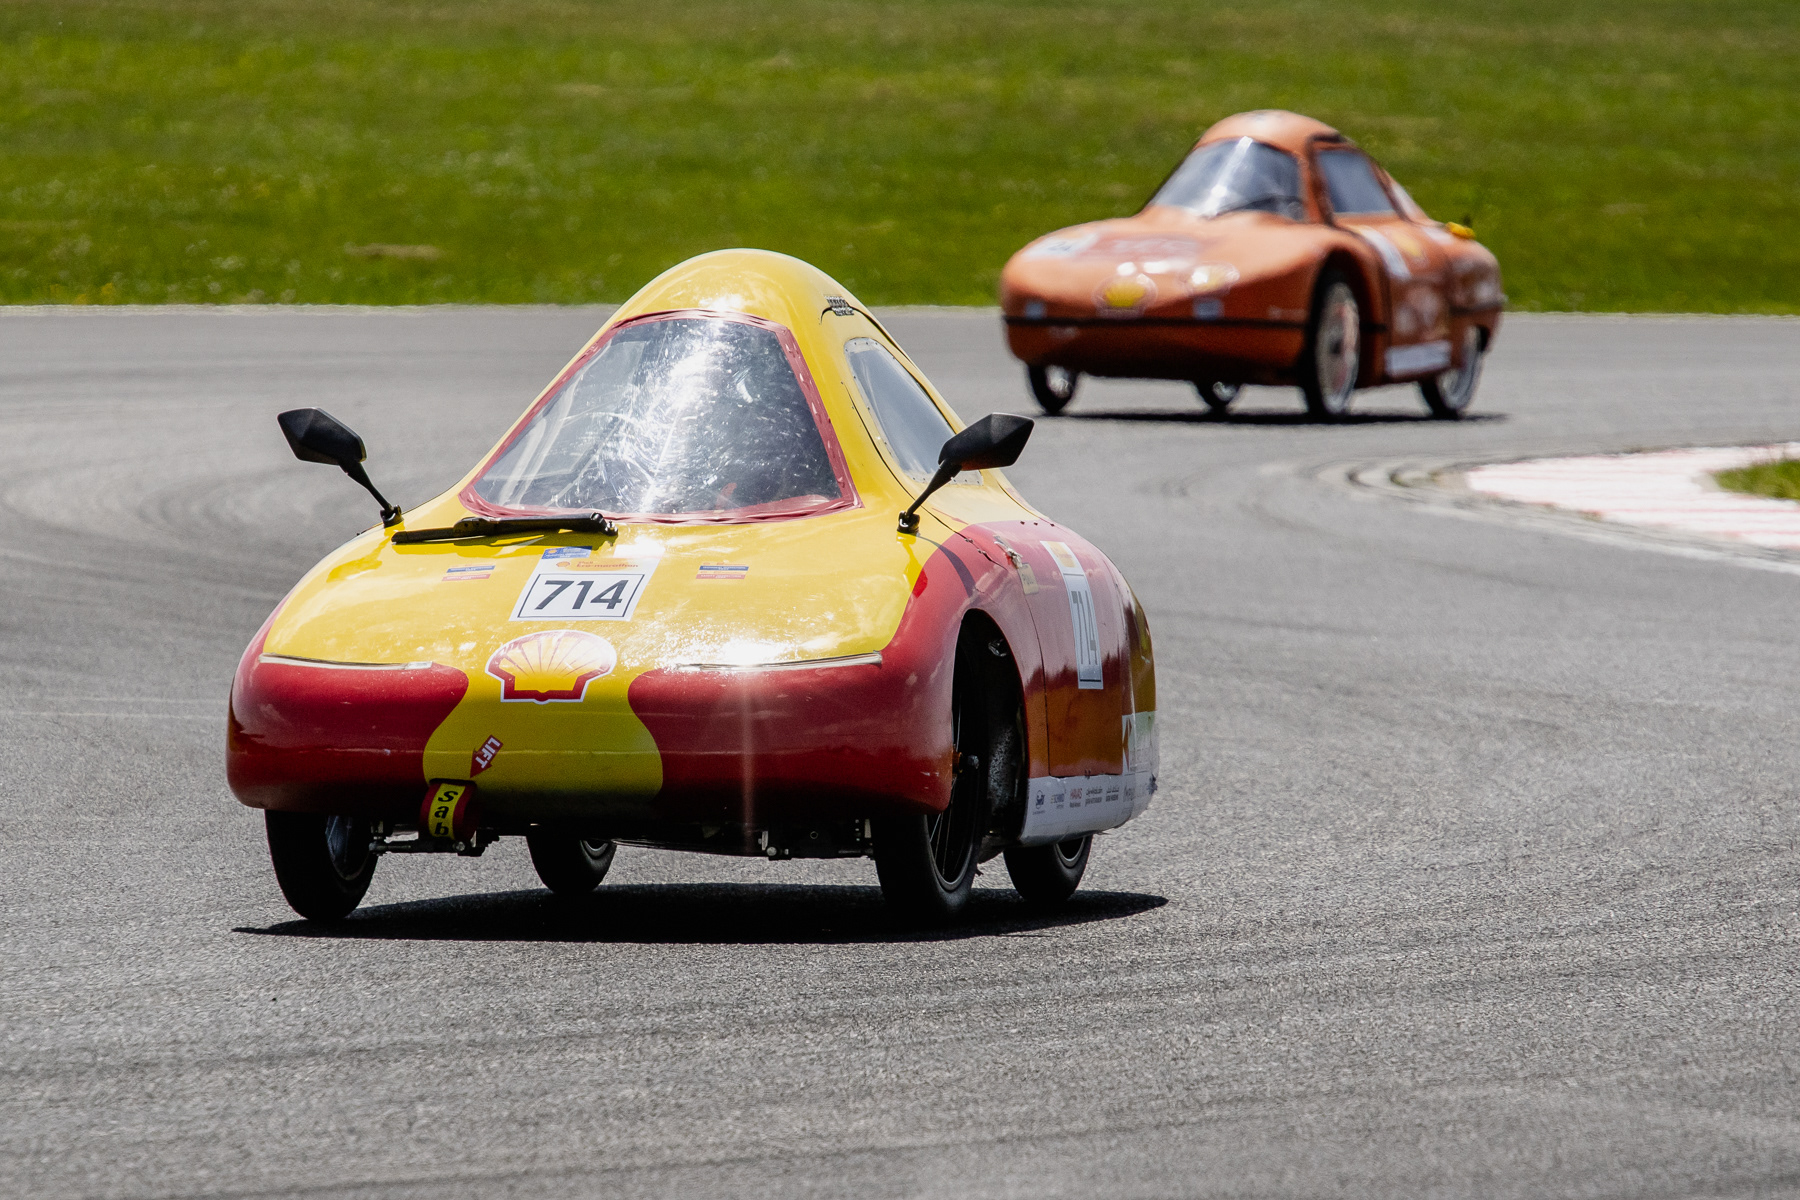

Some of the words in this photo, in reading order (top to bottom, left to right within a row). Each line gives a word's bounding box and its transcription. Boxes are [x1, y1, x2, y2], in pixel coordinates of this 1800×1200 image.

[535, 580, 629, 609] 714
[1070, 590, 1099, 665] 714
[475, 737, 501, 769] LIFT
